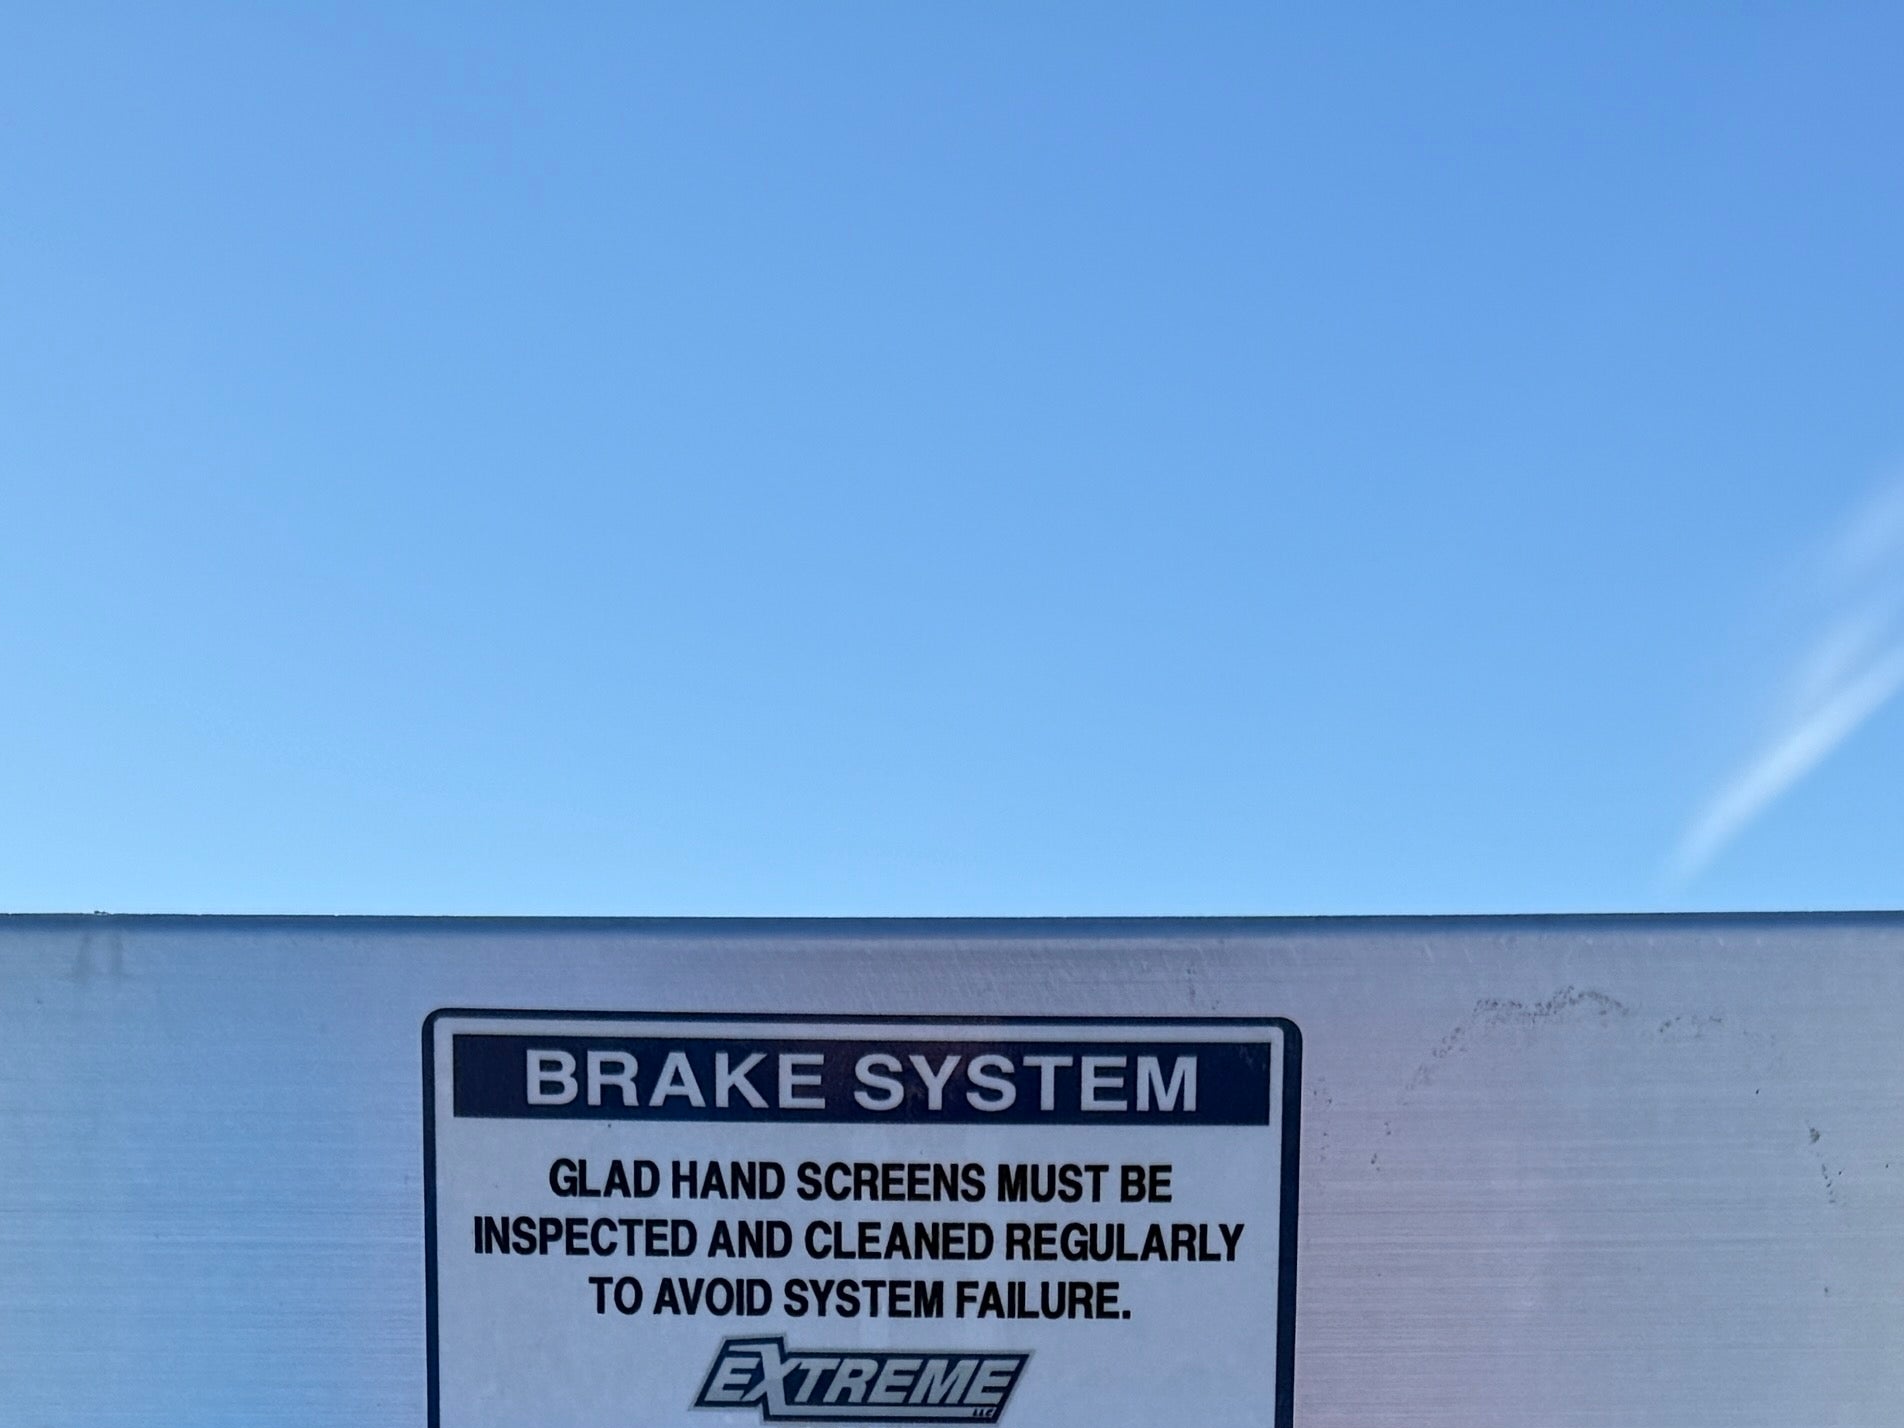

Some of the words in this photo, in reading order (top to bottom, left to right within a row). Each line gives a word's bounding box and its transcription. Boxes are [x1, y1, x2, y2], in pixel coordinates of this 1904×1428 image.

[525, 1049, 826, 1110] BRAKE
[852, 1053, 1198, 1113] SYSTEM
[548, 1157, 661, 1199] GLAD
[671, 1160, 786, 1201] HAND
[796, 1161, 986, 1204] SCREENS
[997, 1163, 1110, 1204] MUST
[1120, 1164, 1173, 1204] BE
[473, 1215, 698, 1258] INSPECTED
[707, 1219, 793, 1260] AND
[804, 1220, 994, 1262] CLEANED
[1005, 1222, 1245, 1263] REGULARLY
[588, 1276, 644, 1317] TO
[652, 1277, 773, 1318] AVOID
[783, 1278, 944, 1320] SYSTEM
[955, 1280, 1132, 1321] FAILURE.
[702, 1341, 1023, 1416] EXTREME
